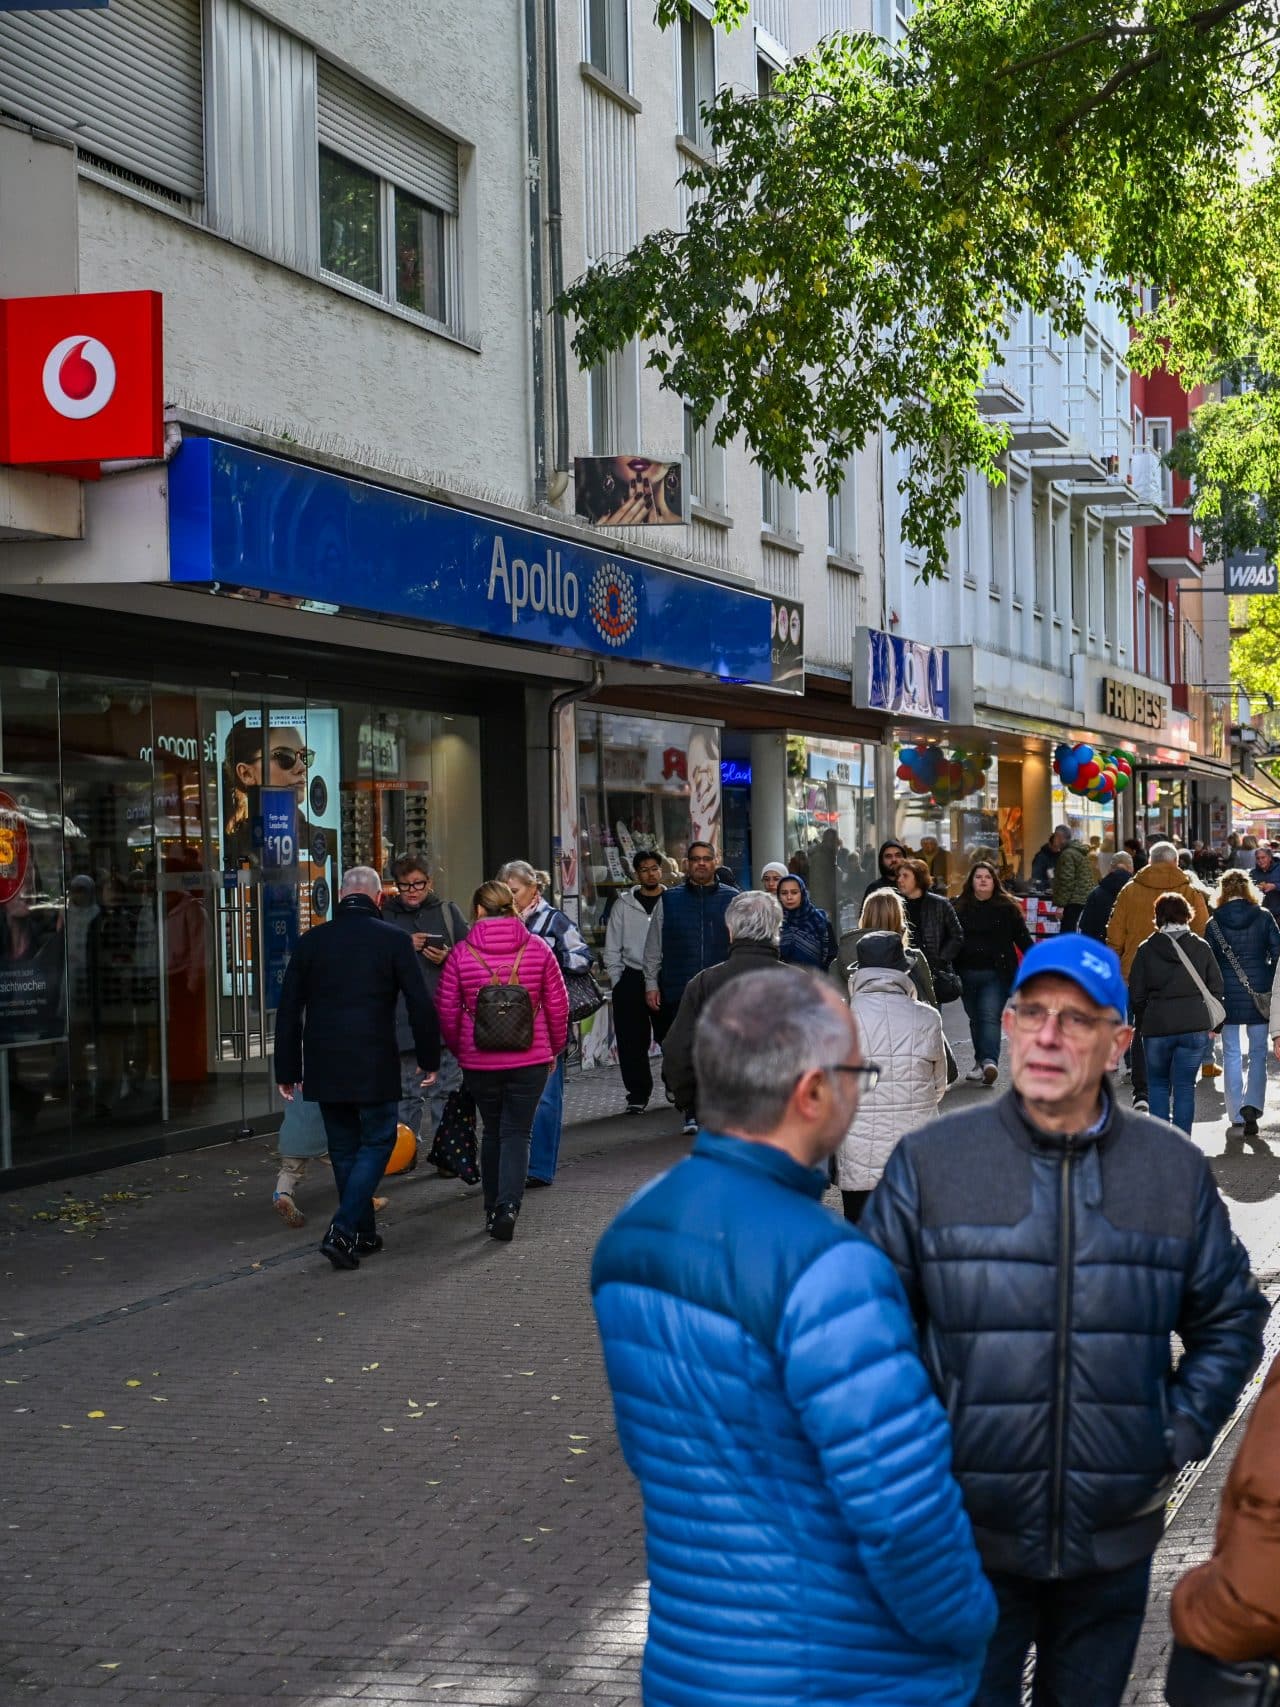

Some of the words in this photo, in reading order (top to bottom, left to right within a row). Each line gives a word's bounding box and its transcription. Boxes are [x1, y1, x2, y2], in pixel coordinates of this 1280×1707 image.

[487, 535, 578, 624] Apollo
[1229, 566, 1275, 587] WAAS
[1106, 678, 1168, 729] FROBESE
